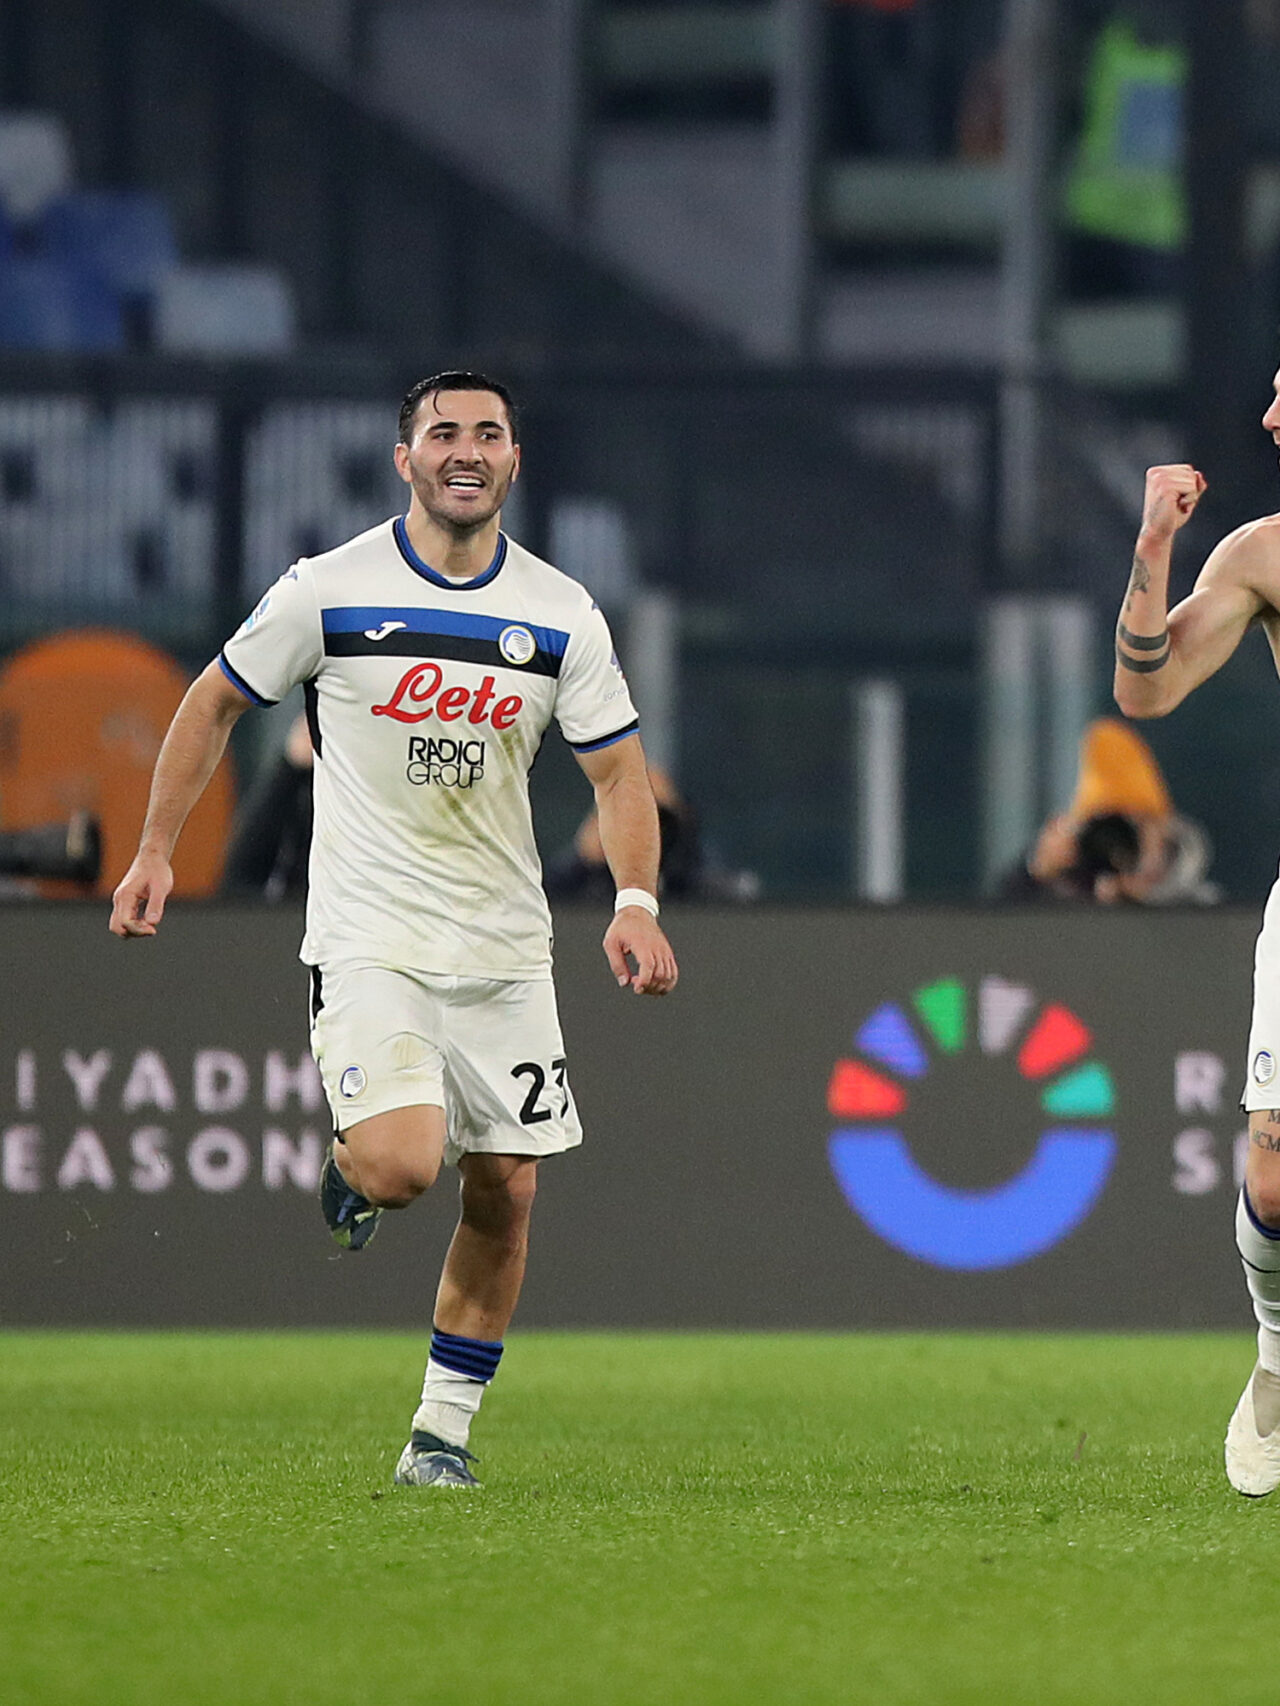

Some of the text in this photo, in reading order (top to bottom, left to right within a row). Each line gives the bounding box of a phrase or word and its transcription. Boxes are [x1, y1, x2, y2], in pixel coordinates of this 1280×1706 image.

[371, 662, 523, 729] Lete
[408, 736, 485, 767] RADICI
[407, 761, 484, 788] GROUP
